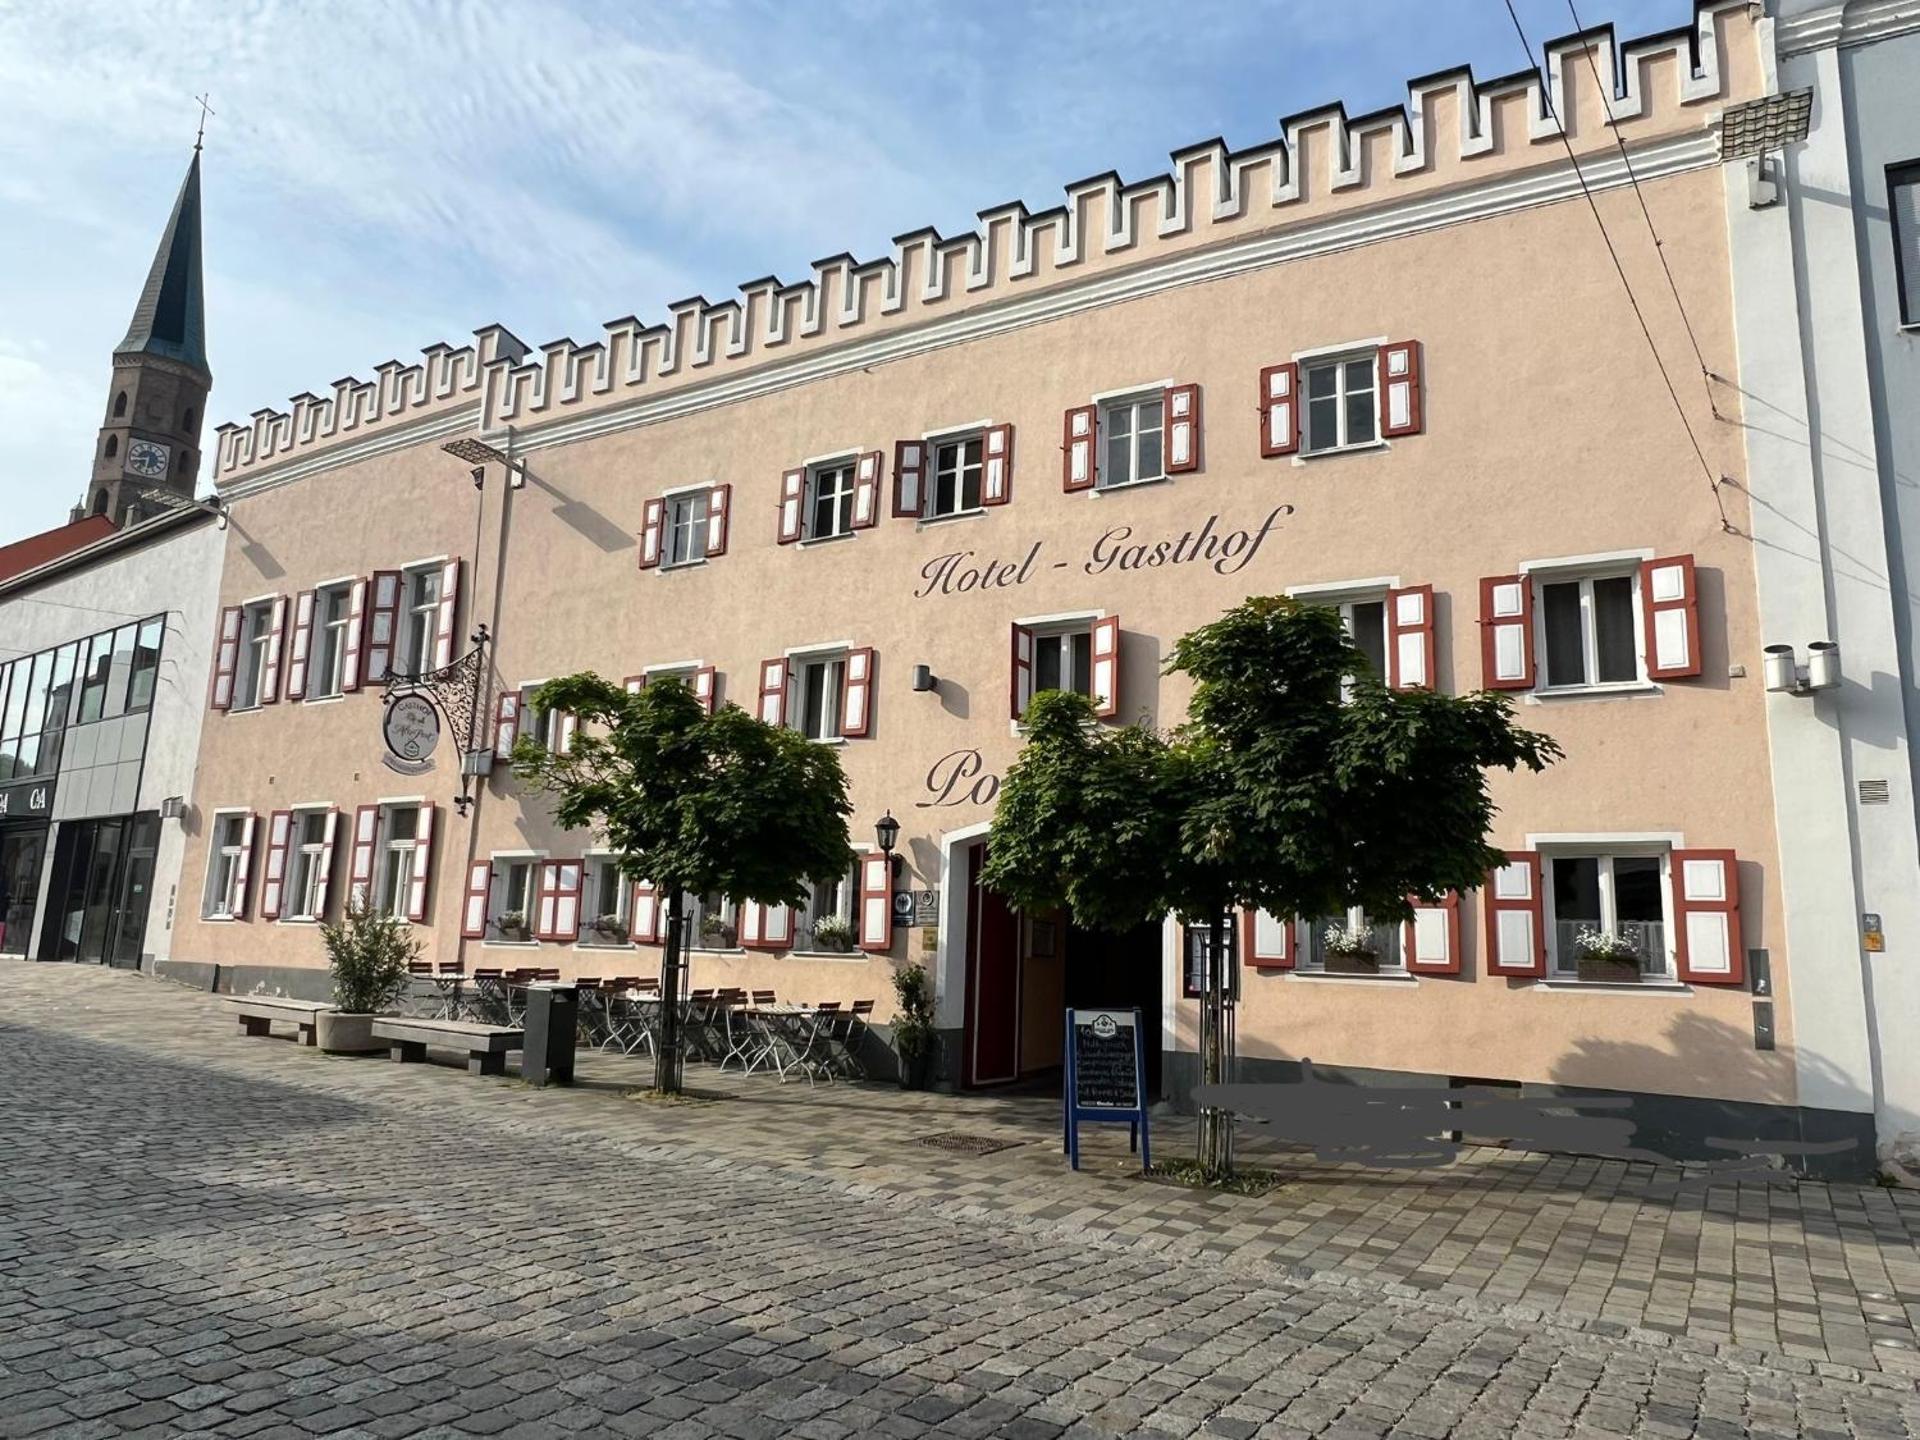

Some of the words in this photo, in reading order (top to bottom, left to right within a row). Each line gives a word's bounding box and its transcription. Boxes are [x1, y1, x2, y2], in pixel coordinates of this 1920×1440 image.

[914, 541, 1042, 598] Hotel
[1084, 504, 1294, 576] Gasthof
[915, 747, 1000, 808] Po
